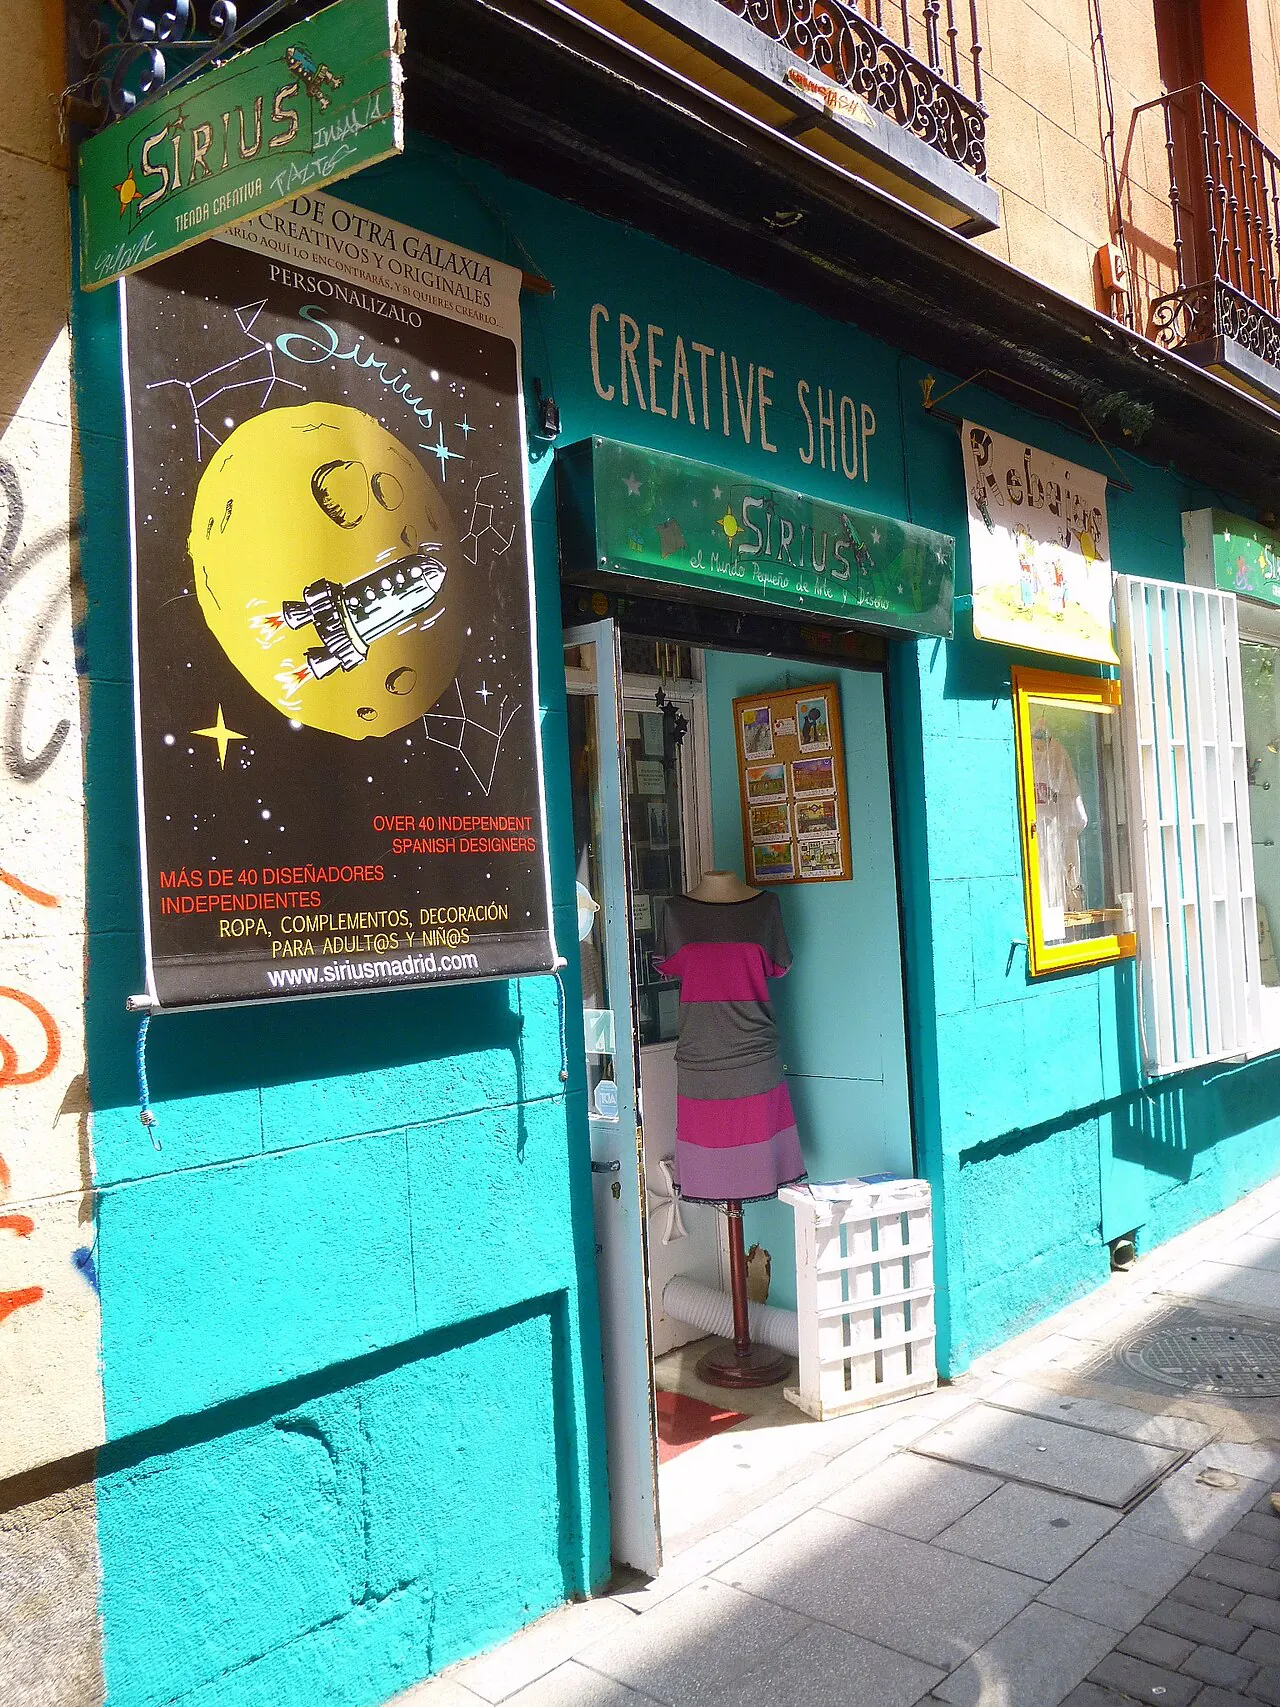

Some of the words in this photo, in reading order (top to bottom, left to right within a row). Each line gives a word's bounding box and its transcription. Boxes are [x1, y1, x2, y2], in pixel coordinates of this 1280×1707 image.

[137, 83, 299, 217] SIRIUS
[175, 203, 209, 232] TIENDA
[213, 178, 262, 215] CREATIVA
[258, 212, 370, 264] CREATIVOS
[372, 252, 384, 269] Y
[388, 258, 491, 308] ORIGINALES
[290, 195, 326, 225] DE
[331, 209, 397, 251] OTRA
[402, 236, 493, 287] GALAXIA
[260, 236, 290, 254] AQUÍ
[293, 247, 309, 260] LO
[312, 252, 393, 291] ENCONTRARÁS,
[412, 290, 454, 311] QUIERES
[269, 263, 422, 329] PERSONALIZALO
[275, 304, 433, 429] Sirius
[589, 303, 778, 453] CREATIVE
[797, 379, 877, 482] SHOP
[969, 428, 1102, 549] Rebajas
[738, 496, 855, 581] SIRIUS
[710, 551, 747, 579] Mundo
[752, 561, 791, 597] Pequeño
[795, 575, 810, 593] de
[814, 576, 835, 599] Arte
[373, 815, 416, 832] OVER
[418, 816, 436, 832] 40
[438, 816, 533, 832] INDEPENDENT
[392, 838, 456, 854] SPANISH
[459, 837, 537, 853] DESIGNERS
[159, 866, 204, 889] MÁS
[208, 869, 235, 888] DE
[237, 868, 259, 886] 40
[263, 863, 385, 885] DISEÑADORES
[161, 891, 323, 915] INDEPENDIENTES
[219, 917, 273, 938] ROPA,
[281, 908, 414, 934] COMPLEMENTOS,
[420, 900, 509, 926] DECORACIÓN
[272, 937, 316, 959] PARA
[322, 932, 399, 955] ADULT@S
[406, 931, 416, 949] Y
[422, 925, 471, 949] NIÑ@S
[267, 951, 480, 988] www.siriusmadrid.com
